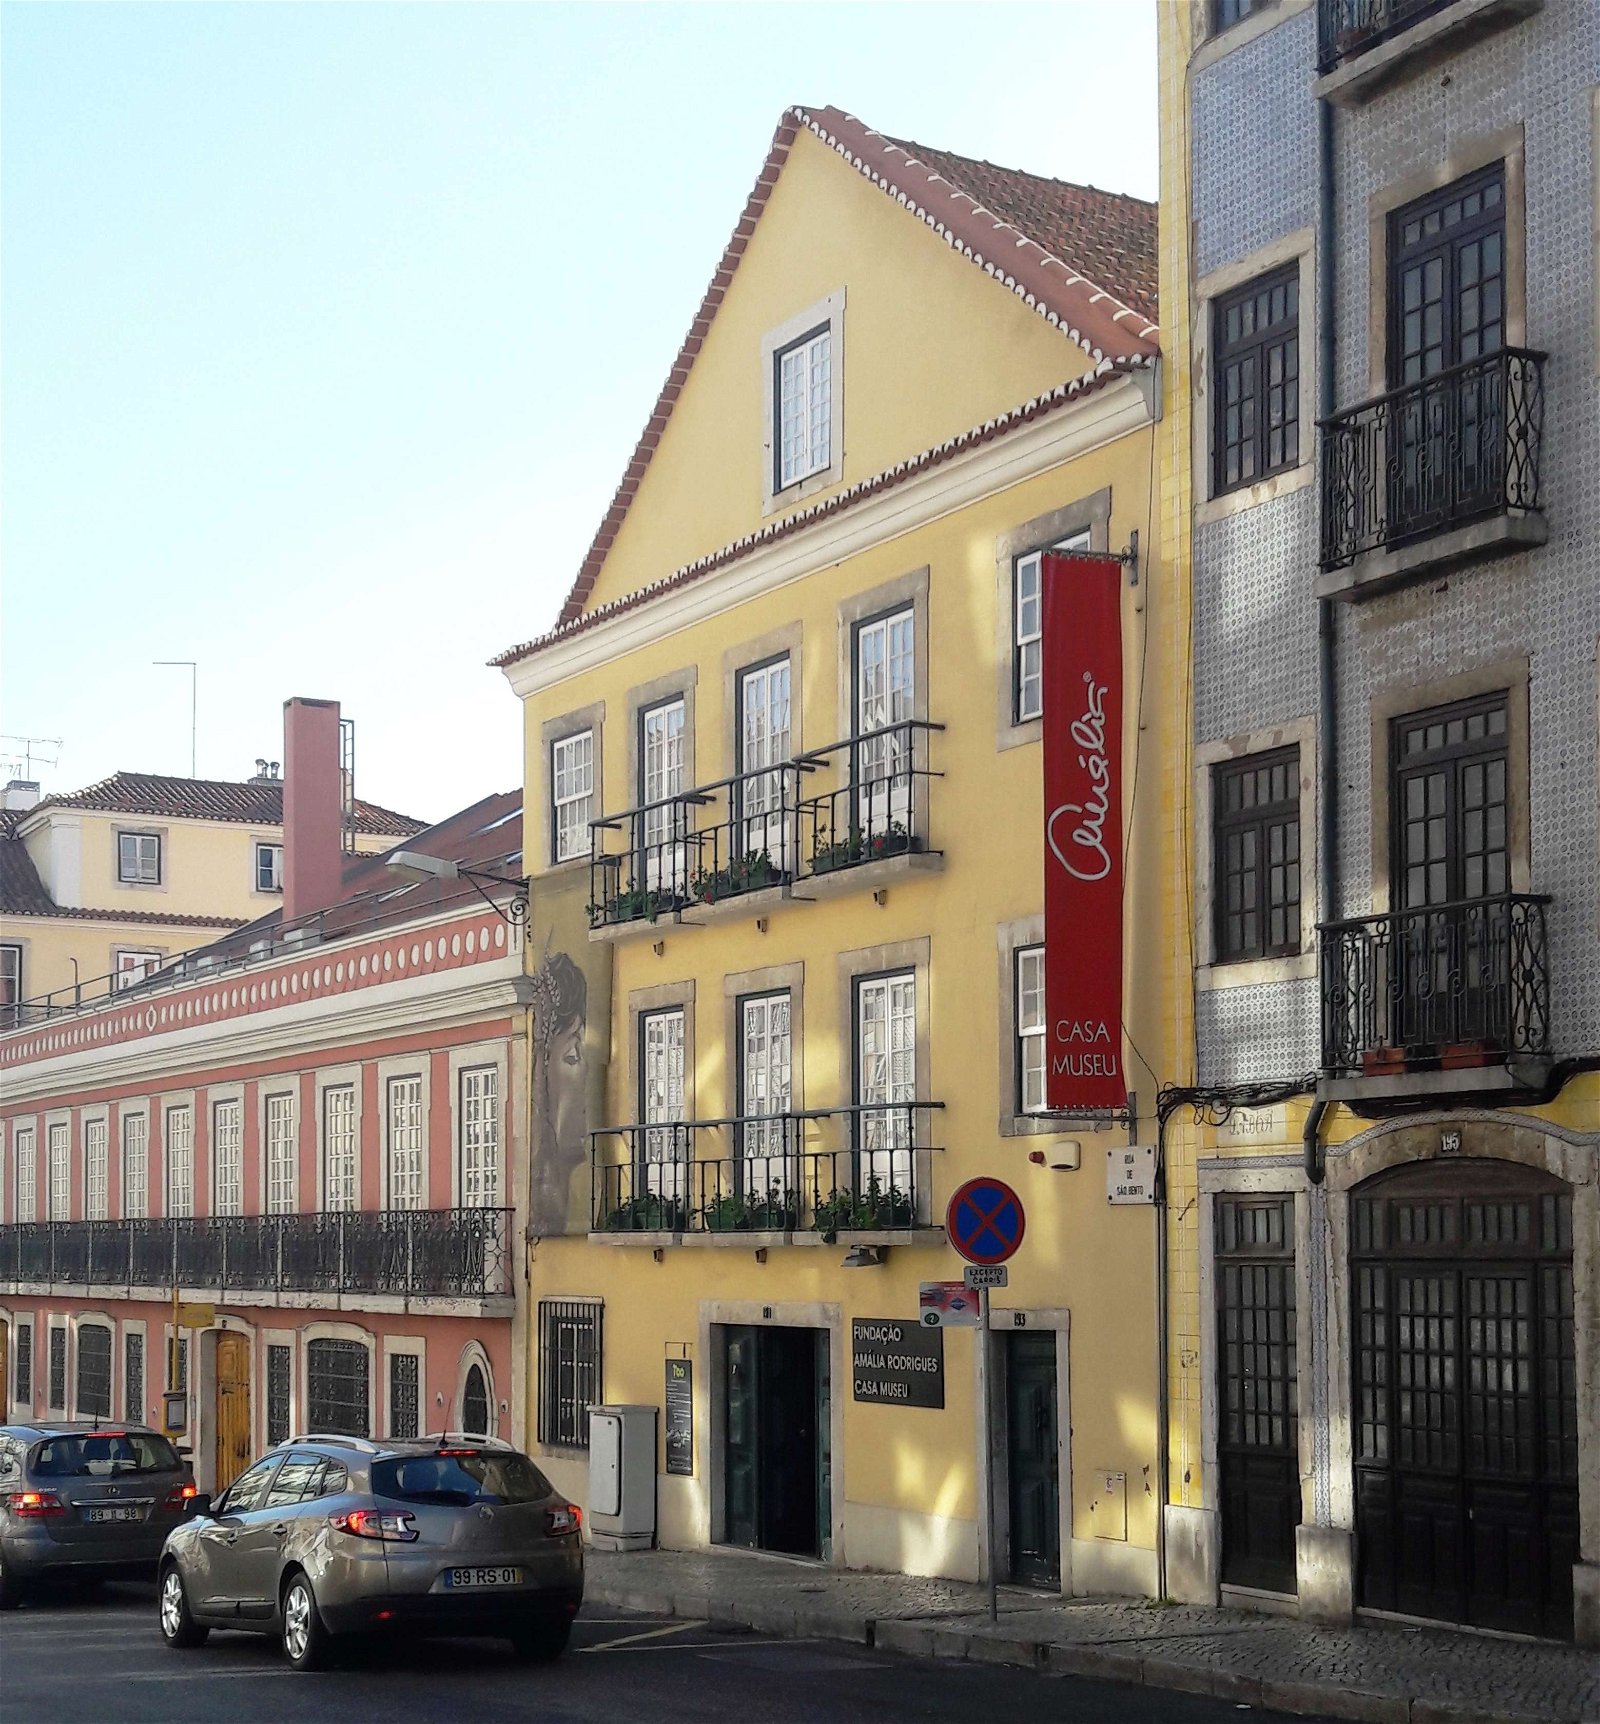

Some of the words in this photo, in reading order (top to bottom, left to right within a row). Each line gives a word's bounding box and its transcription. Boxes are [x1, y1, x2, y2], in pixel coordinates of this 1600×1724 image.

[1056, 1019, 1111, 1043] CASA
[1052, 1053, 1117, 1076] MUSEU
[1442, 1132, 1460, 1151] 195
[1126, 1169, 1133, 1180] DE
[1128, 1185, 1144, 1195] BENTO
[853, 1323, 901, 1346] FUNDAÇÃO
[853, 1349, 886, 1369] AMÁLIA
[887, 1354, 939, 1373] RODRIGUES
[854, 1379, 879, 1396] CASA
[879, 1381, 909, 1398] MUSEU
